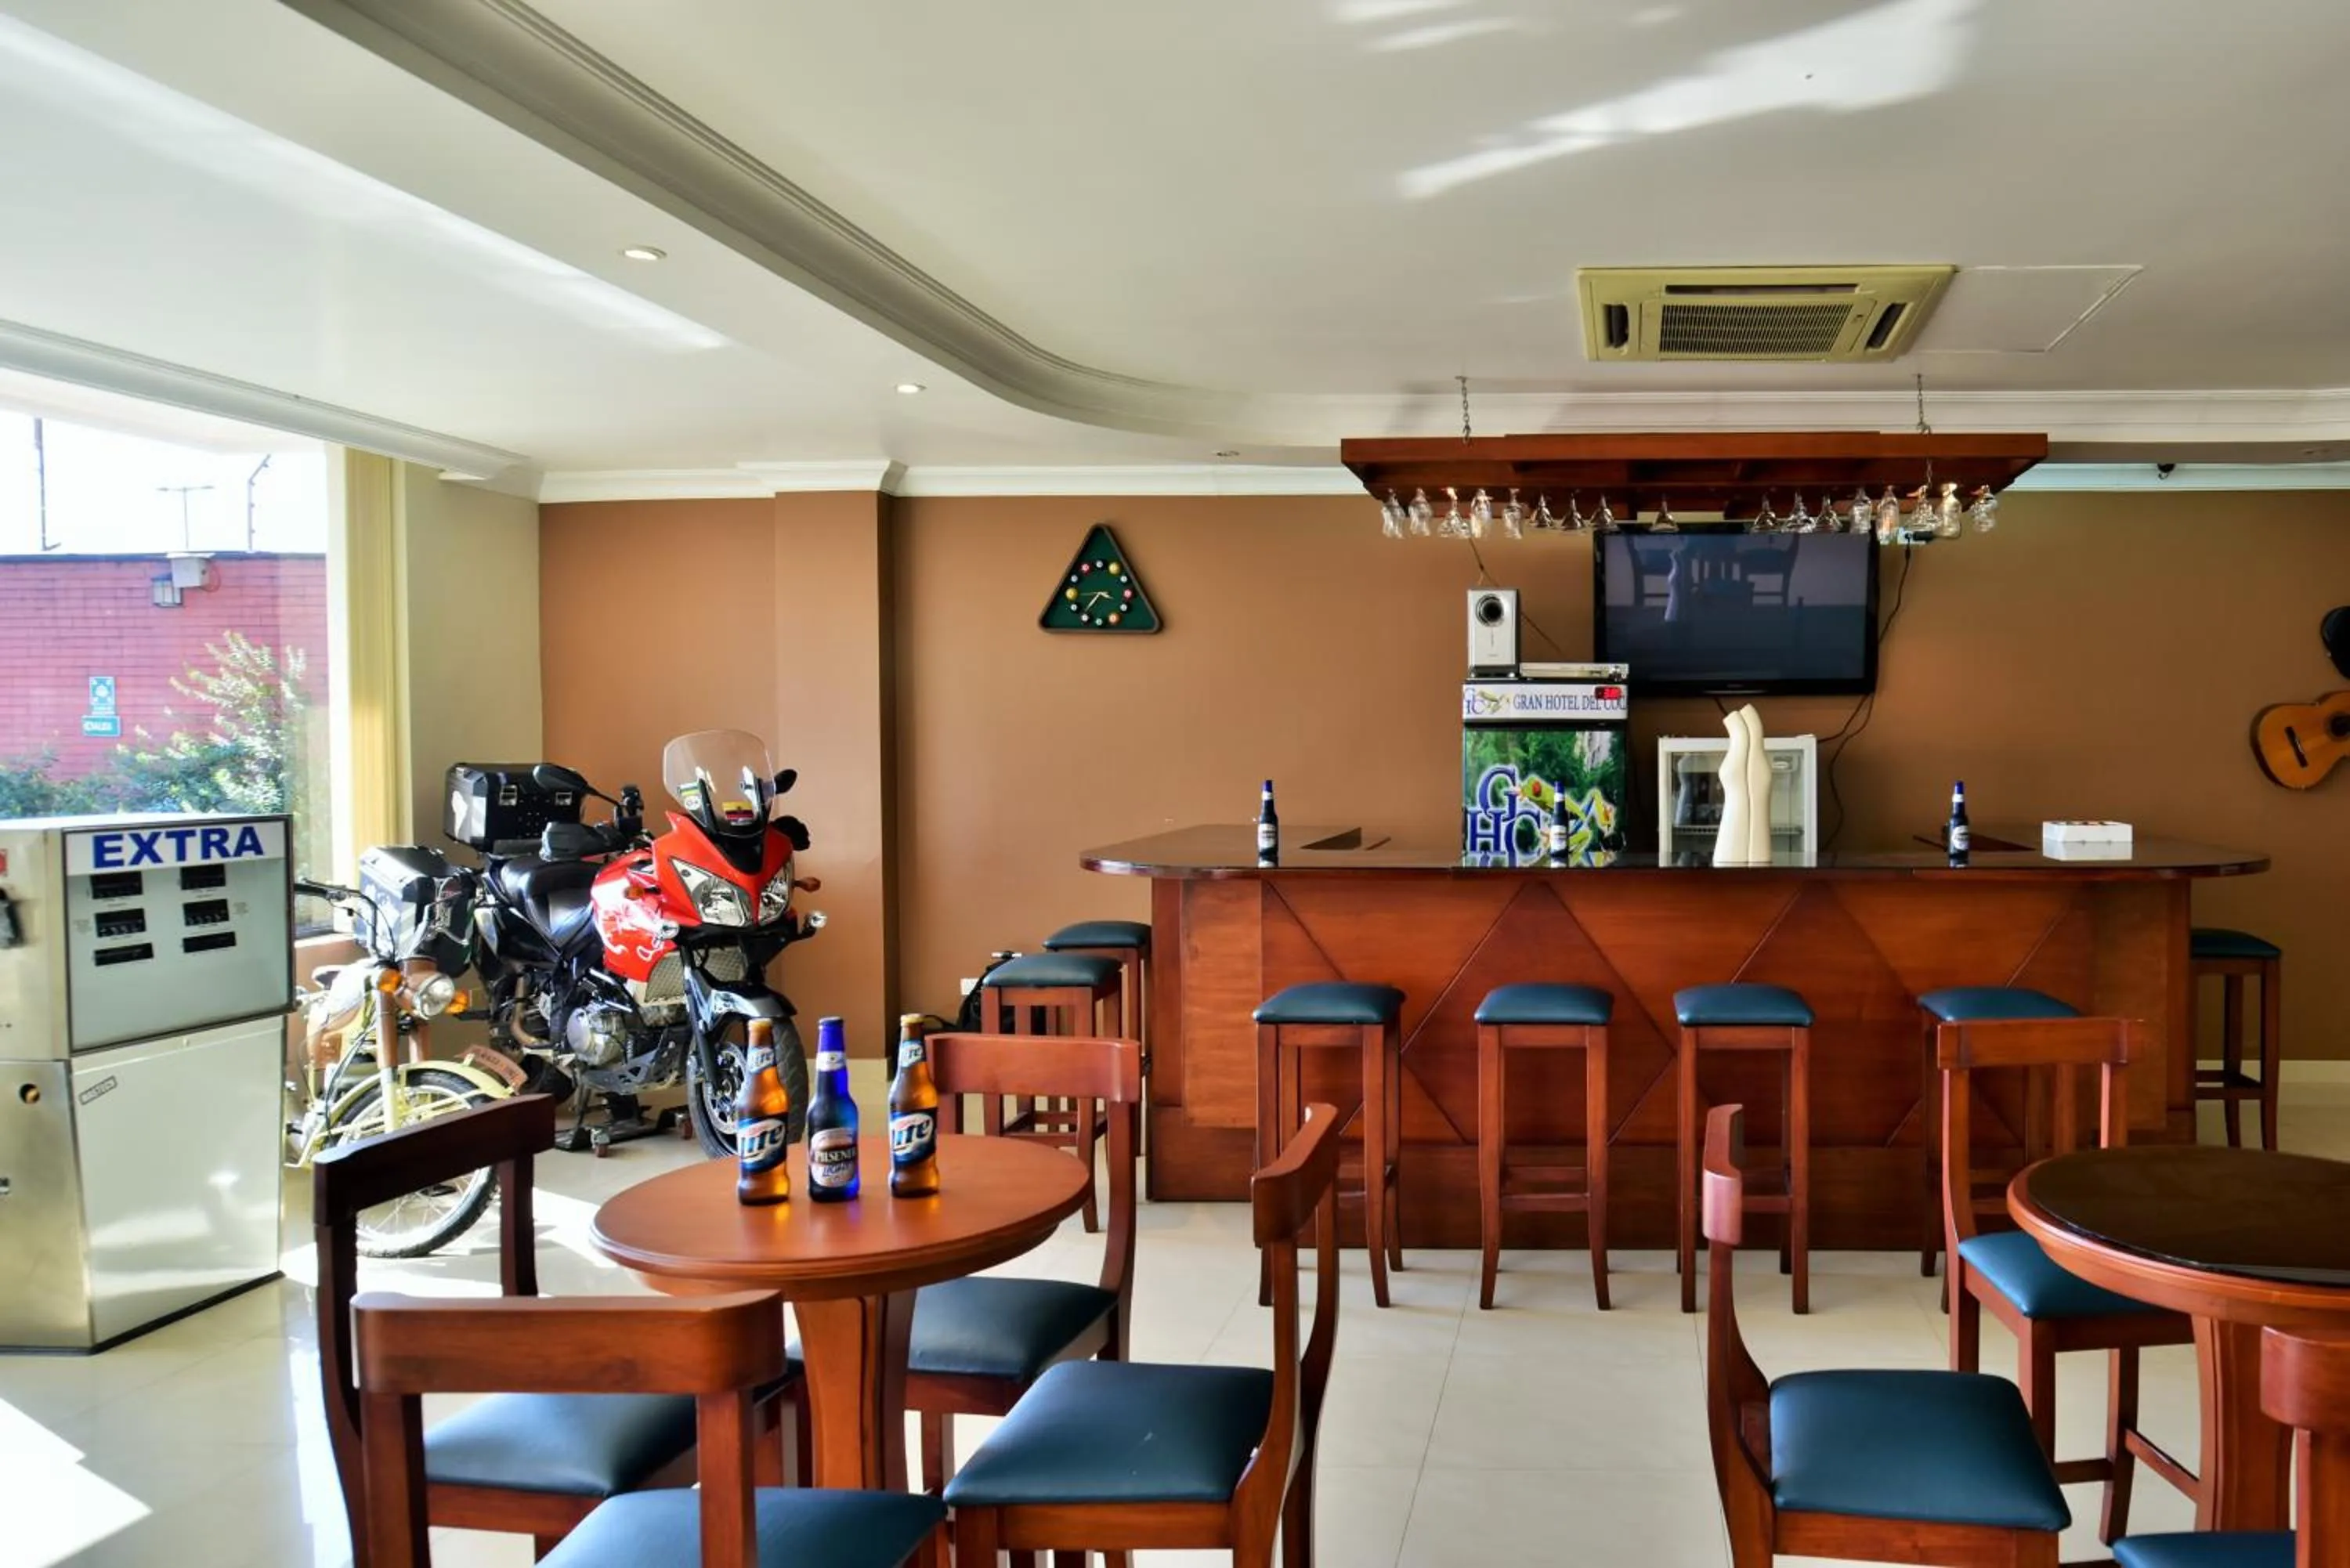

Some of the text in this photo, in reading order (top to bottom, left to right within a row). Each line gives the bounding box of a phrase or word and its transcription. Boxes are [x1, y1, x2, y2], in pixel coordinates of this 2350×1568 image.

[1513, 694, 1627, 710] GRAN HOTEL DEL COC
[92, 826, 264, 869] EXTRA
